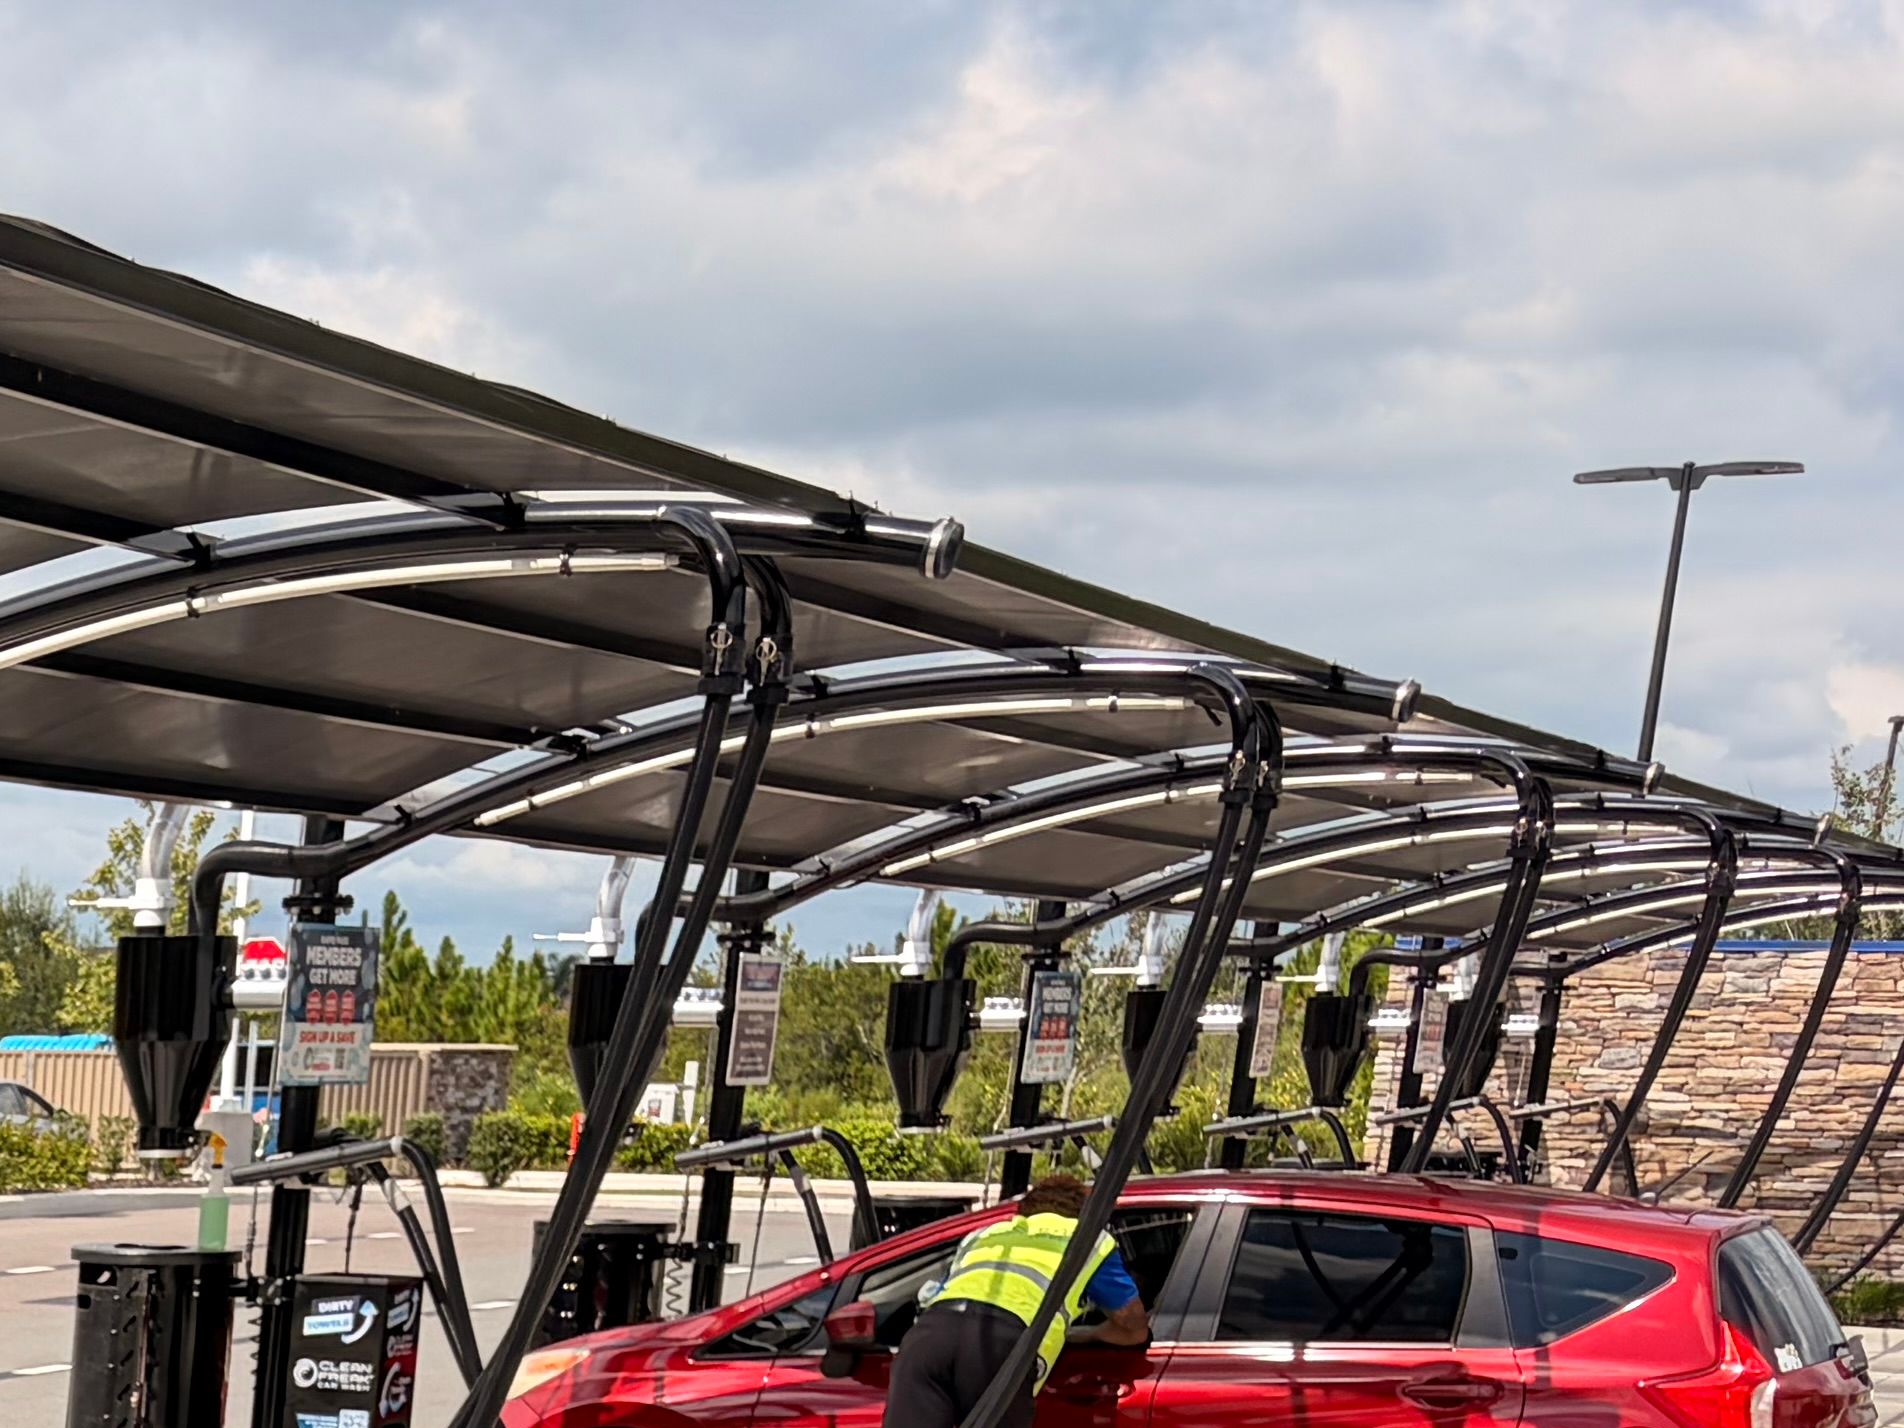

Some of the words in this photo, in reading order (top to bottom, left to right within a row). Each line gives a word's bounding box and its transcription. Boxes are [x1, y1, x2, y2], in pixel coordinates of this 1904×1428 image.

[306, 946, 362, 968] MEMBERS
[309, 968, 328, 984] GET
[329, 968, 358, 985] MORE
[318, 1300, 354, 1313] DIRTY
[319, 1360, 373, 1374] CLEAN
[318, 1372, 374, 1384] FREAK
[317, 1381, 338, 1390] CAR
[340, 1382, 371, 1392] WASH
